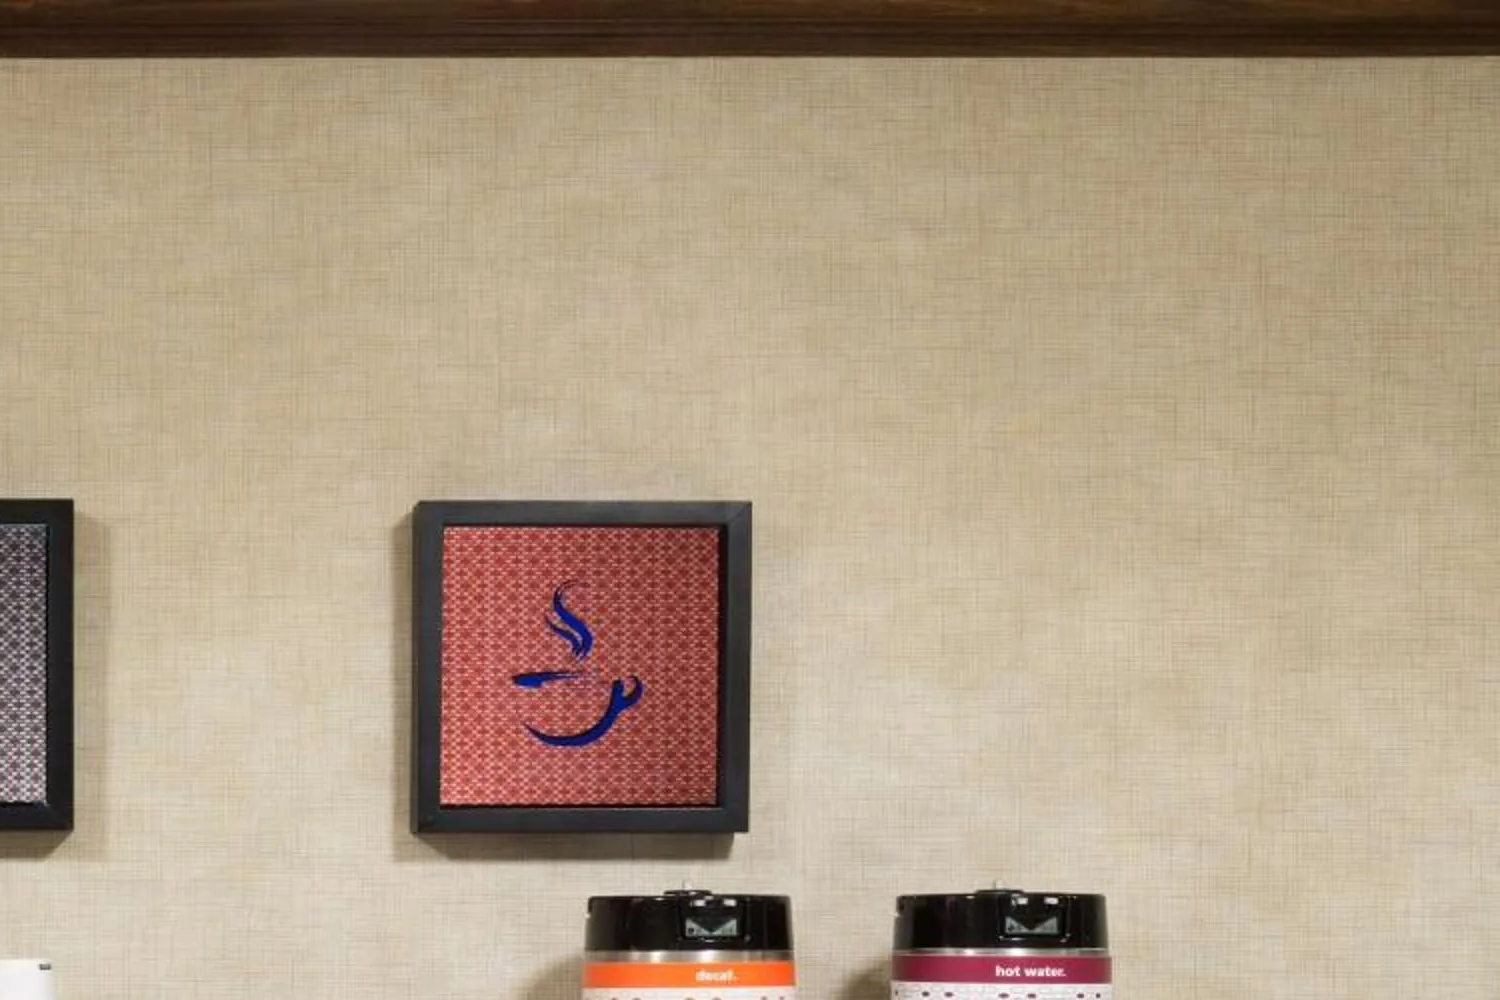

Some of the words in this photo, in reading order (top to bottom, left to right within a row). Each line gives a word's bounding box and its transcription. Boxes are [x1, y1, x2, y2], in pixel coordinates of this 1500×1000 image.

[695, 970, 738, 982] decaf.
[995, 965, 1021, 977] hot
[1024, 966, 1067, 977] water.
